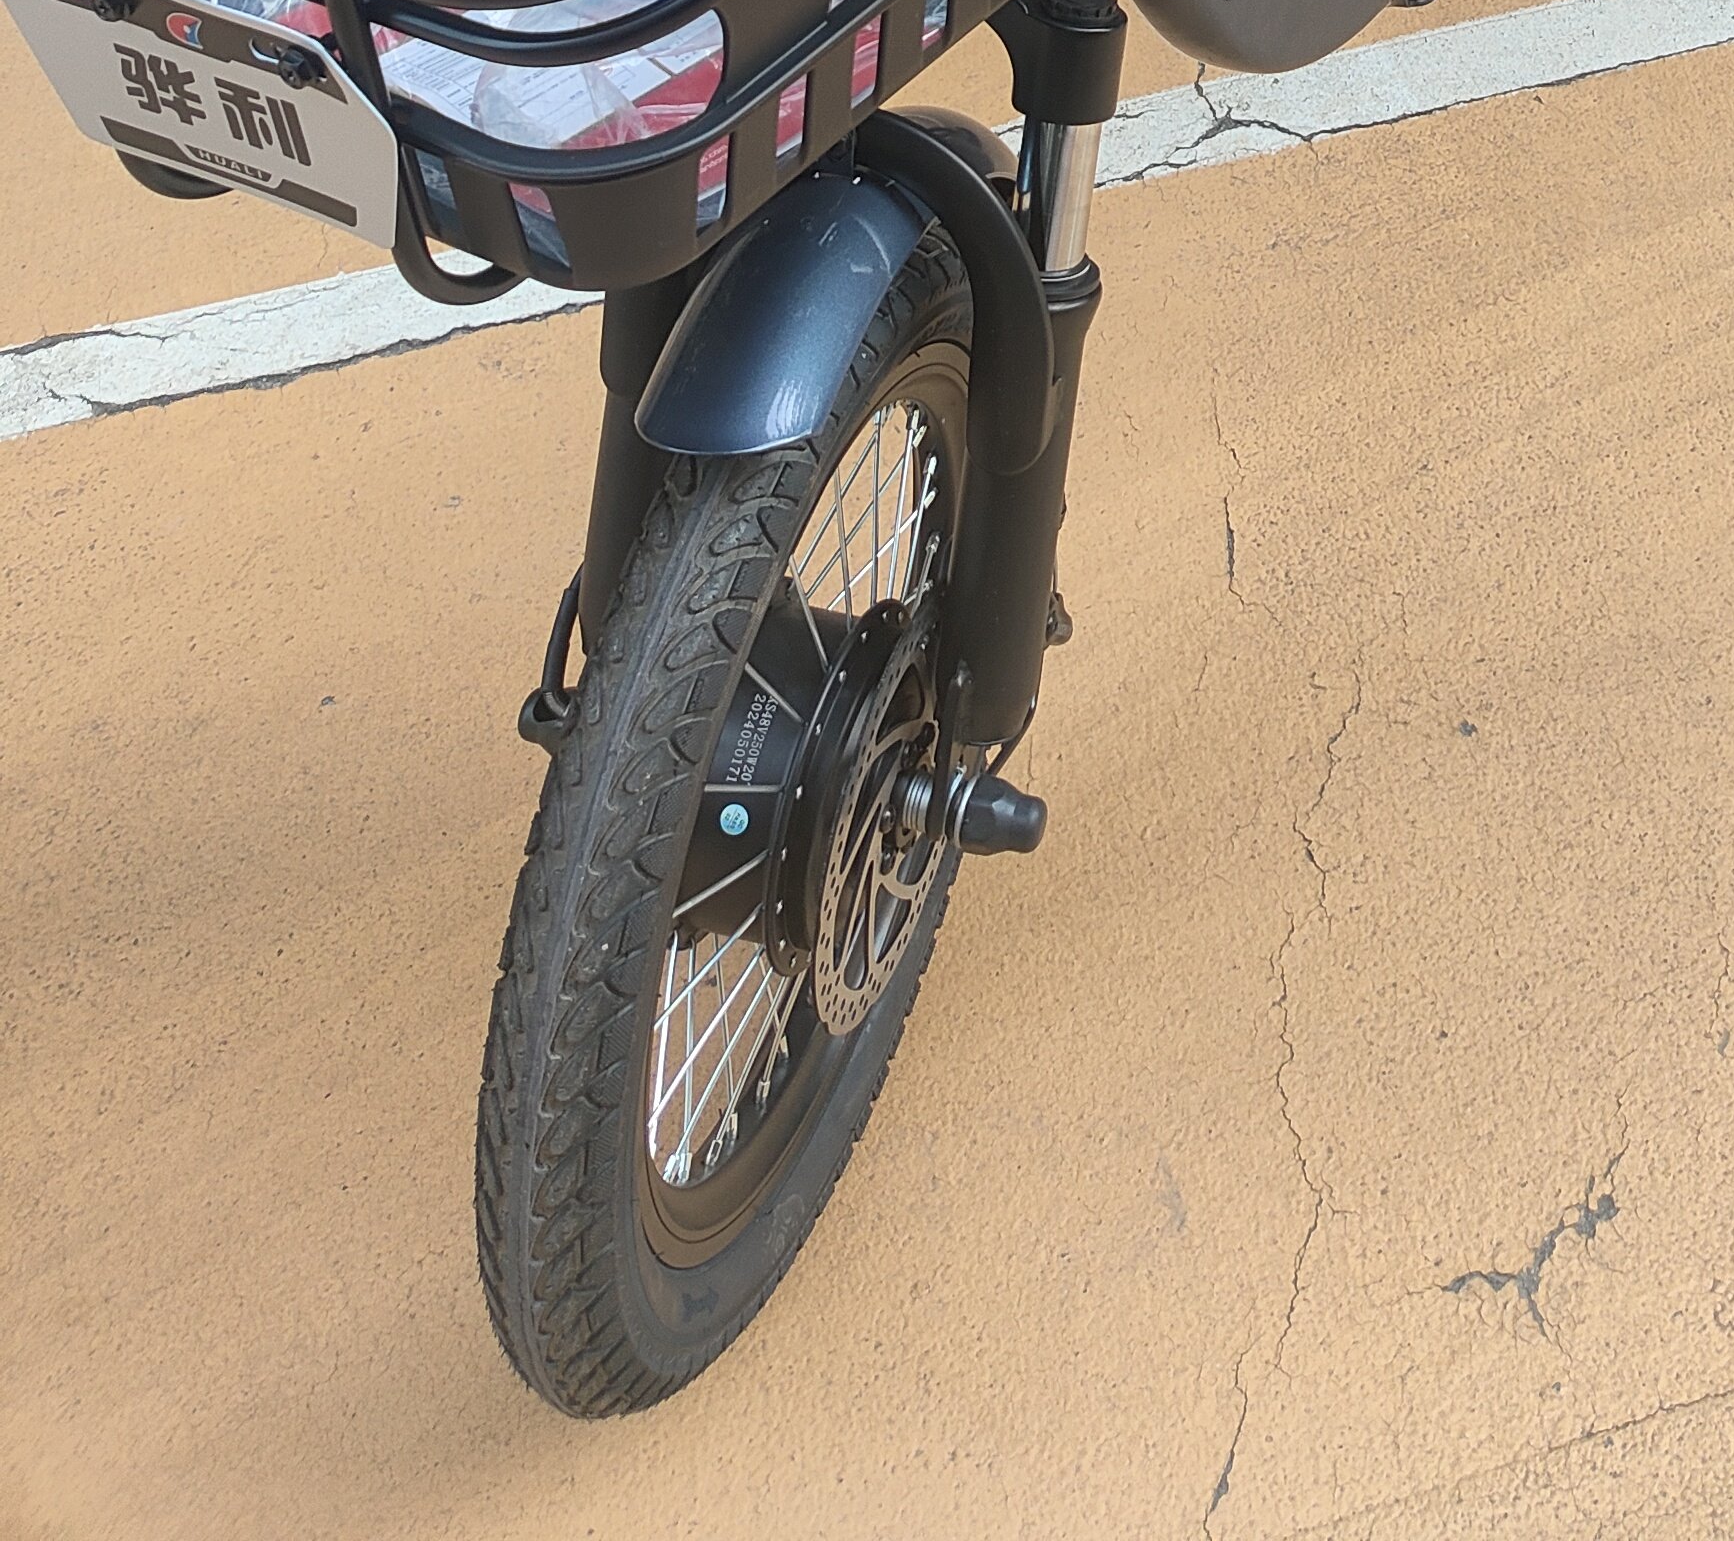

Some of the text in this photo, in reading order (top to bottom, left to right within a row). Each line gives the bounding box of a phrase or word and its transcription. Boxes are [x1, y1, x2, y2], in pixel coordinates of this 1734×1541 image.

[112, 42, 312, 167] 骅利
[198, 148, 265, 180] HUALI
[725, 693, 767, 783] 2024050171
